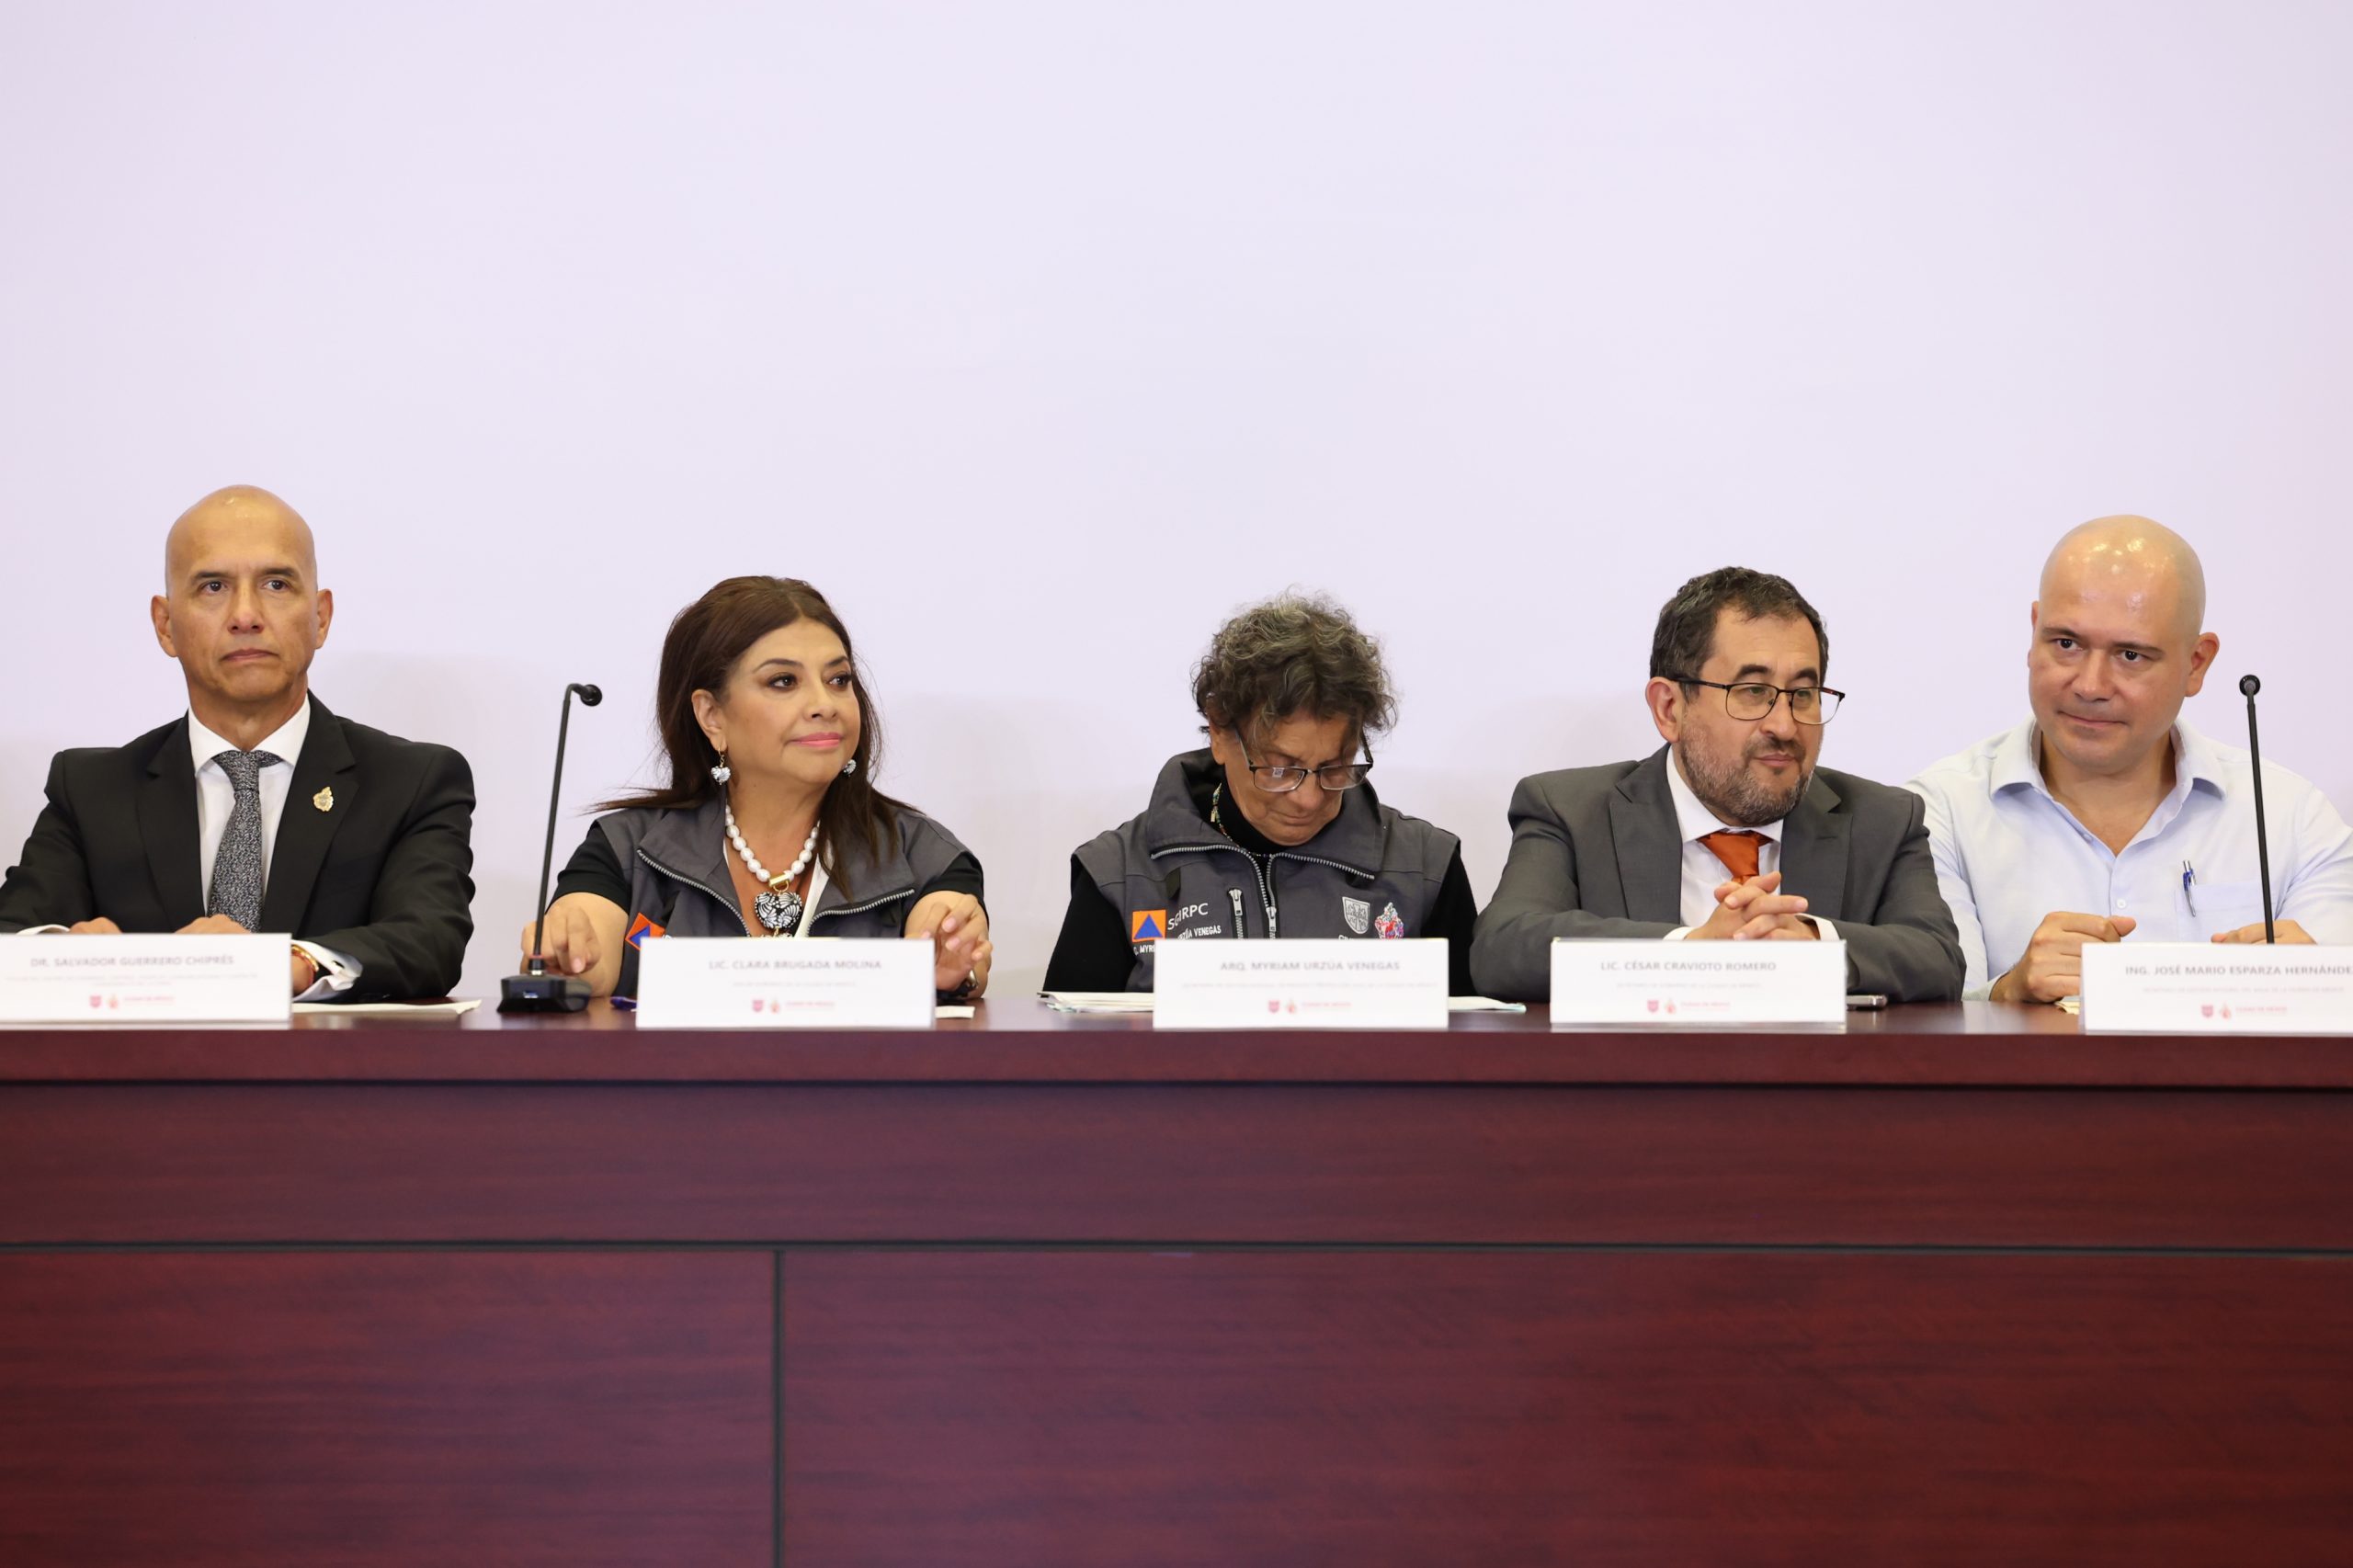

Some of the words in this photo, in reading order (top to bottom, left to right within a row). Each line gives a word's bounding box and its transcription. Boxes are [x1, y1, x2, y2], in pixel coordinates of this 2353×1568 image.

[1167, 903, 1209, 930] SGIRPC
[1176, 927, 1193, 939] RZÚA
[1193, 925, 1222, 937] VENEGAS
[30, 958, 50, 967] DR.
[54, 958, 116, 967] SALVADOR
[119, 957, 182, 966] GUERRERO
[185, 954, 234, 965] CHIPRÉS
[709, 960, 729, 970] LIC.
[733, 960, 769, 970] CLARA
[774, 960, 830, 970] BRUGADA
[835, 960, 881, 970] MOLINA
[1251, 962, 1301, 971] MYRIAM
[1303, 960, 1343, 971] URZÚA
[1347, 961, 1401, 971] VENEGAS
[1600, 961, 1621, 971] LIC.
[1624, 960, 1661, 971] CÉSAR
[1664, 961, 1722, 971] CRAVIOTO
[1725, 961, 1777, 971] ROMERO
[2125, 965, 2150, 975] ING.
[2154, 964, 2181, 975] JOSÉ
[2185, 965, 2226, 975] MARIO
[2229, 965, 2281, 975] ESPARZA
